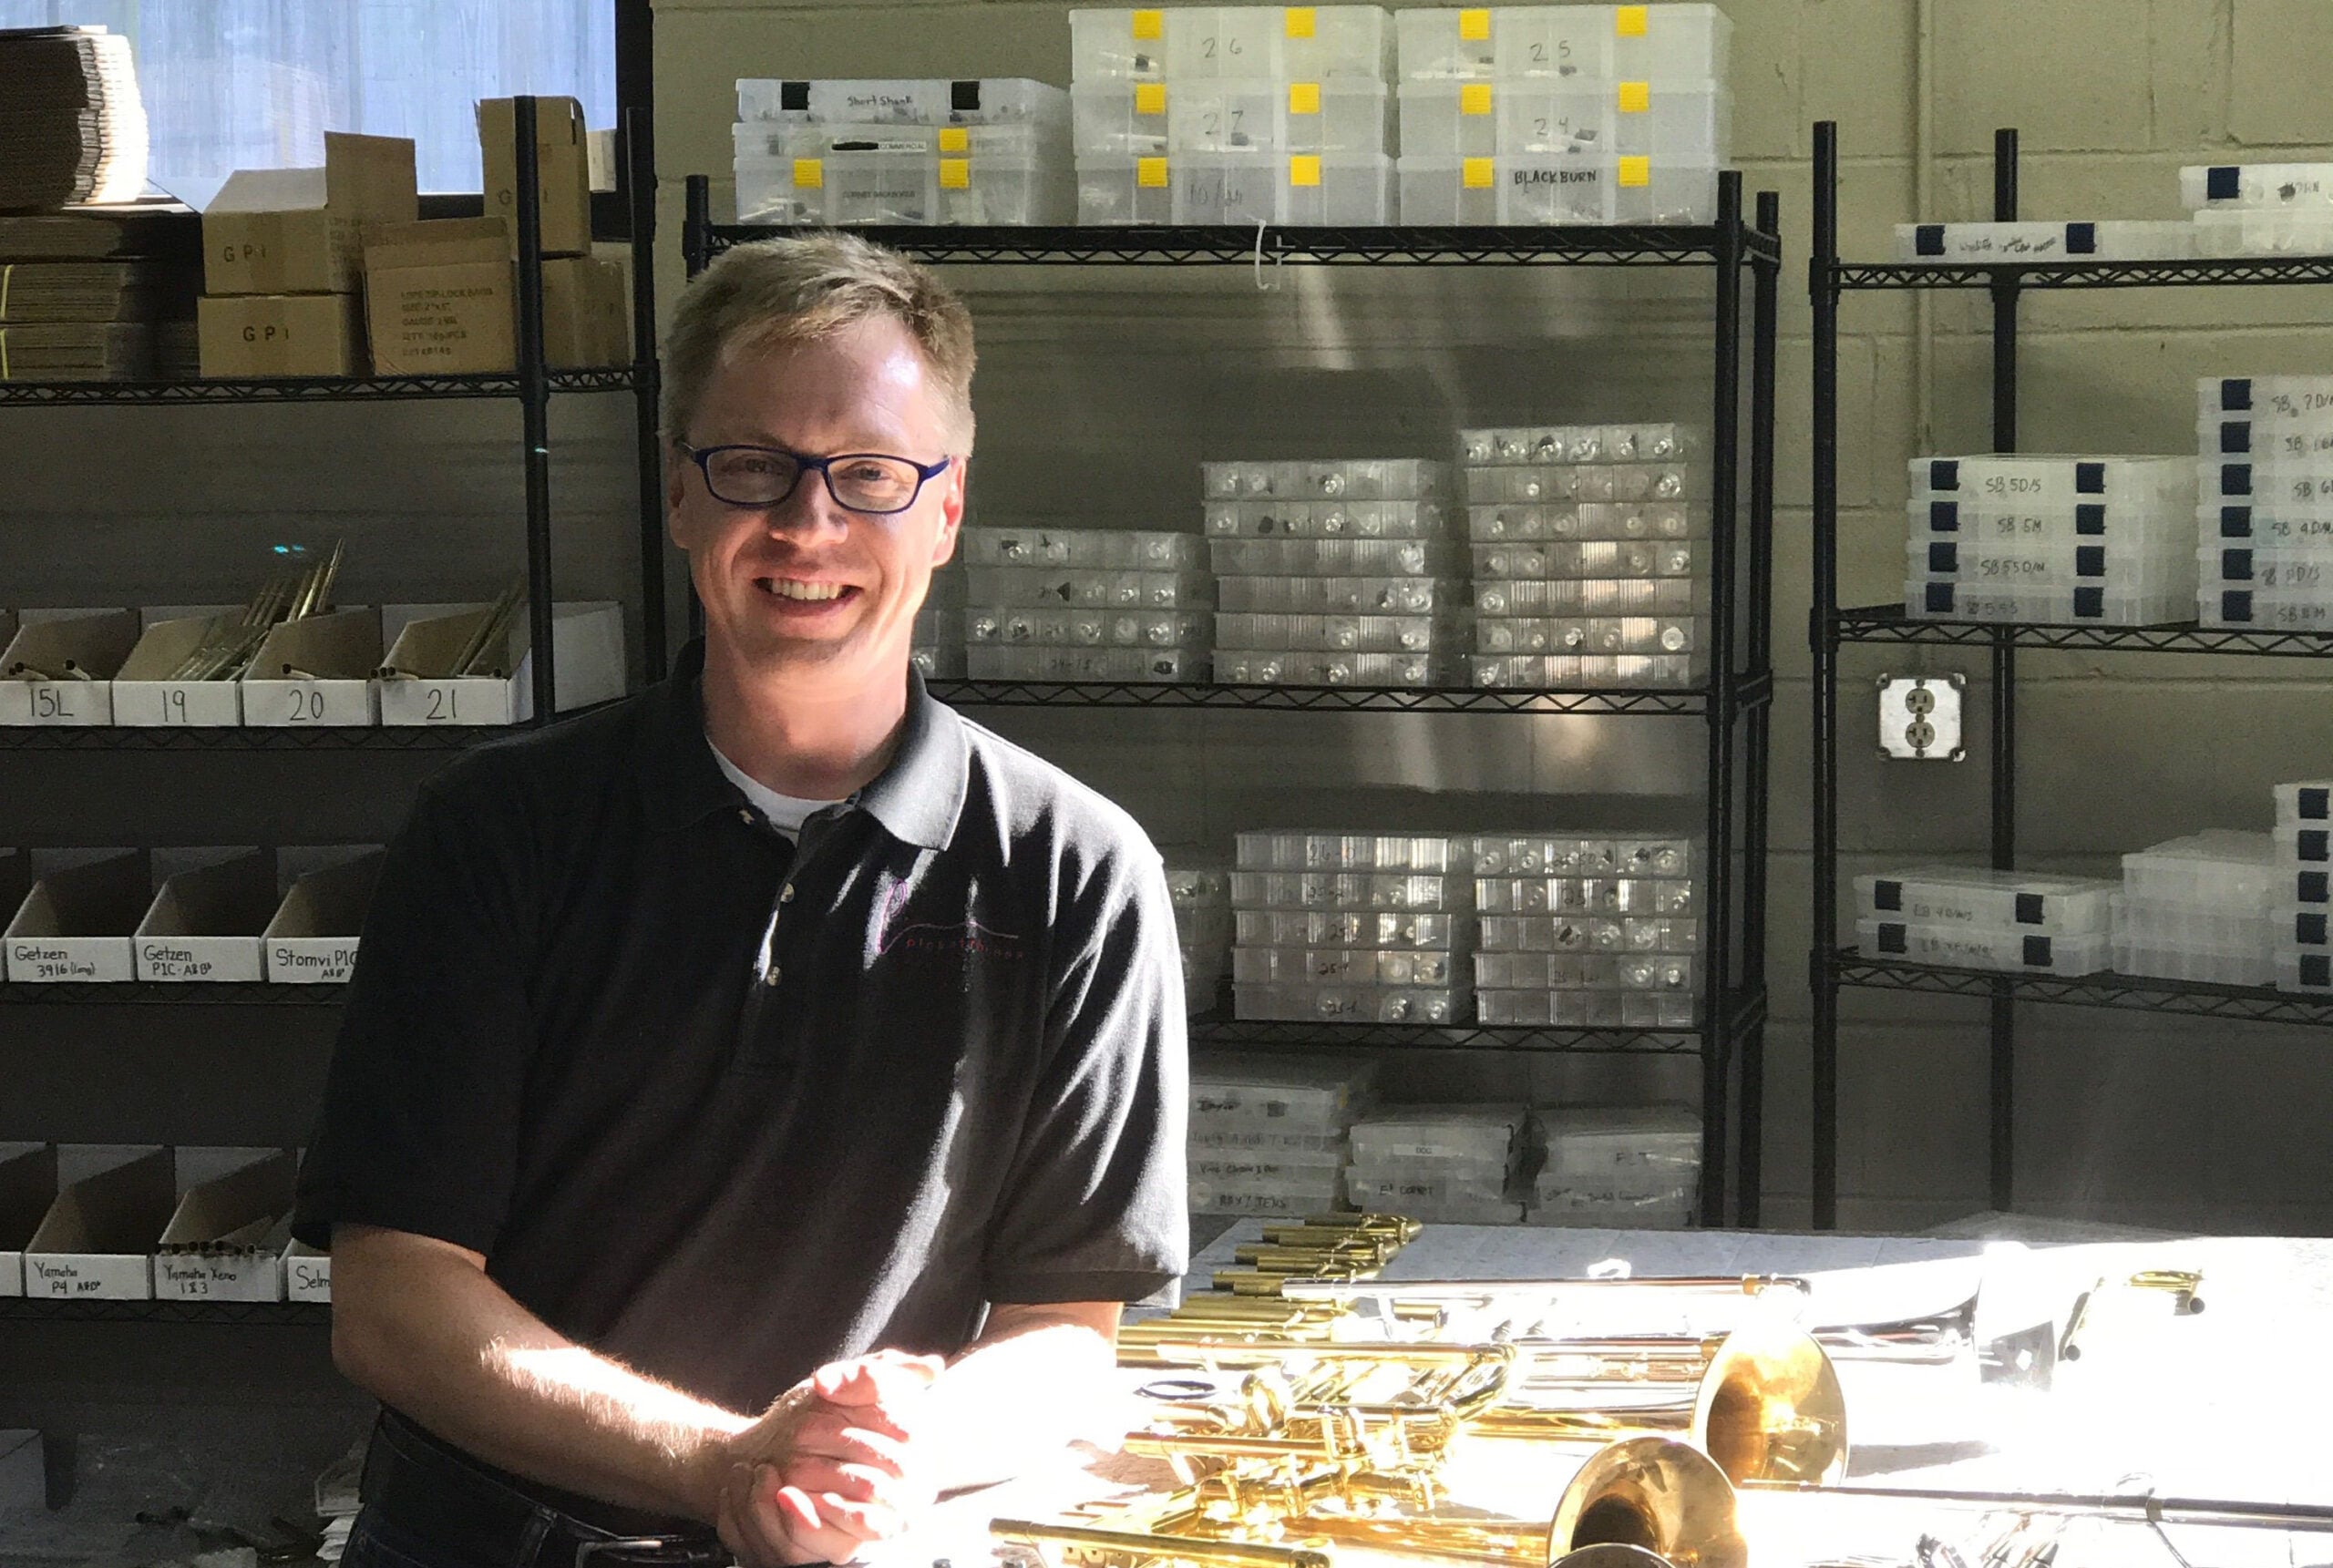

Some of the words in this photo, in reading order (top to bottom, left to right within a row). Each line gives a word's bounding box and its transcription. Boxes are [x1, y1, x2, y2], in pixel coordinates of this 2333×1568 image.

[1200, 36, 1242, 58] 26
[1529, 40, 1571, 61] 25
[847, 95, 877, 107] Short
[1202, 109, 1244, 136] 27
[1534, 117, 1568, 136] 24
[1514, 169, 1597, 186] BLACKBURN
[1986, 477, 2005, 493] SB
[1997, 517, 2015, 534] SB
[1980, 559, 1999, 576] SB
[29, 688, 74, 718] 15L
[162, 689, 186, 723] 19
[288, 688, 324, 721] 20
[426, 688, 457, 720] 21
[15, 946, 67, 961] Getzen
[143, 944, 193, 963] Getzen
[275, 948, 331, 968] Stomvi
[36, 963, 67, 978] 3916
[34, 1262, 78, 1279] Yamaha
[163, 1264, 207, 1281] Yamaha
[211, 1266, 237, 1281] Xeno
[200, 1282, 209, 1295] 3
